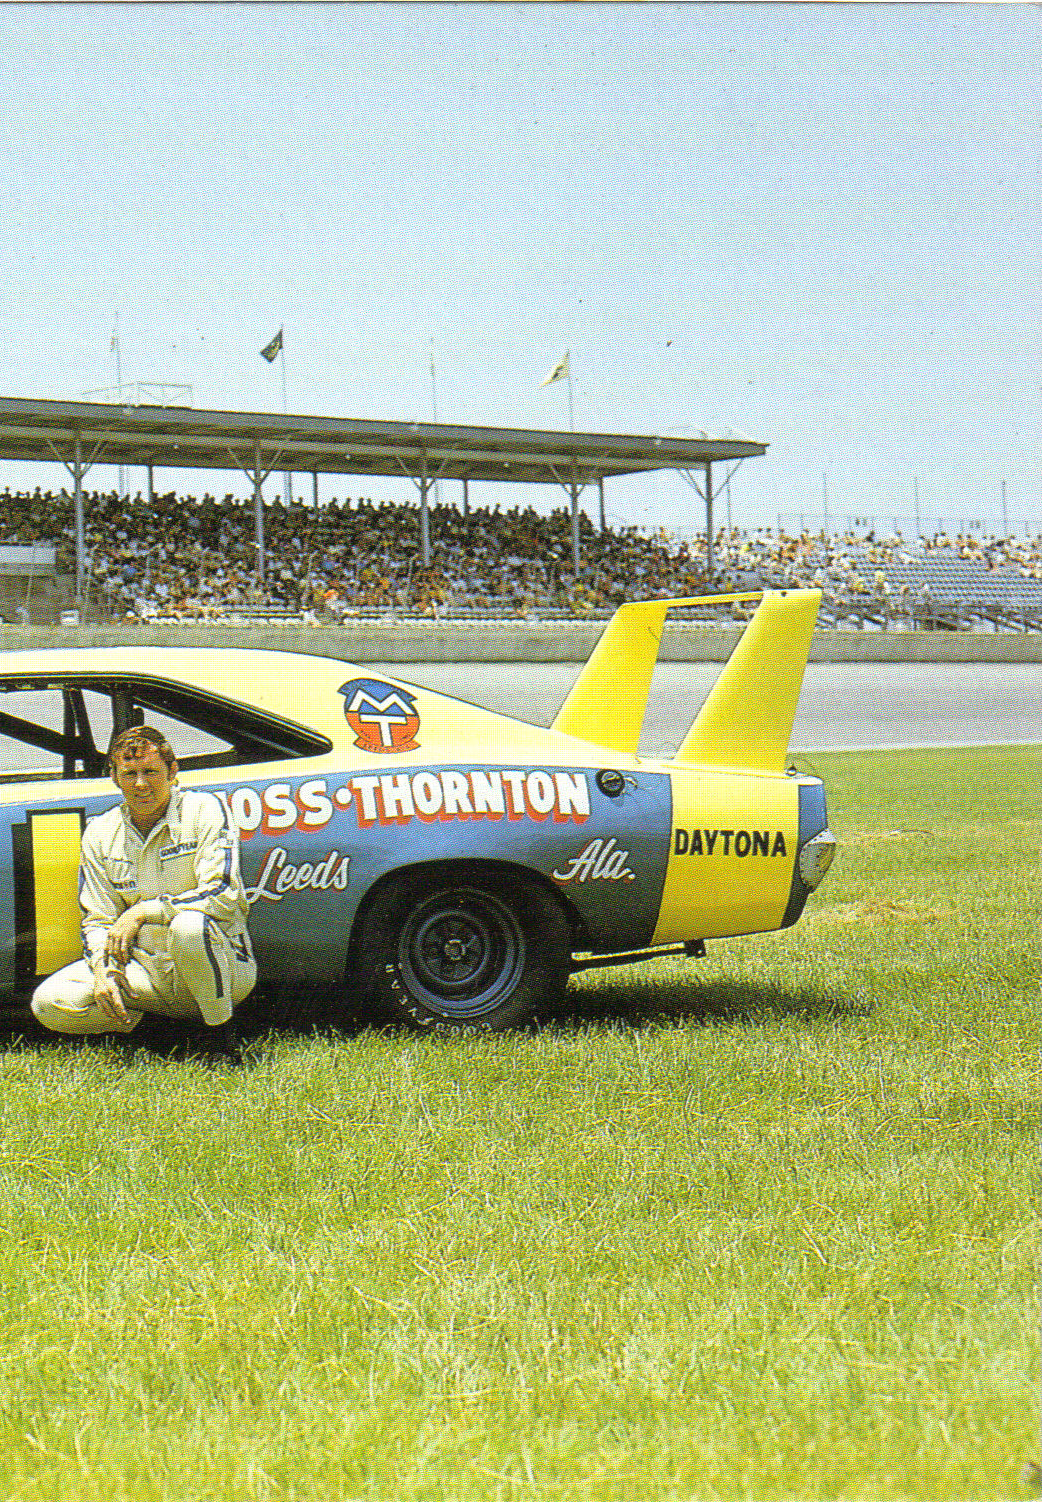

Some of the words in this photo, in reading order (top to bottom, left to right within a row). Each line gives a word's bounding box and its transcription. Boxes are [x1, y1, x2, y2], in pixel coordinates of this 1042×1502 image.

[552, 837, 637, 884] Ala.
[673, 828, 788, 858] DAYTONA
[242, 846, 351, 903] Leeds
